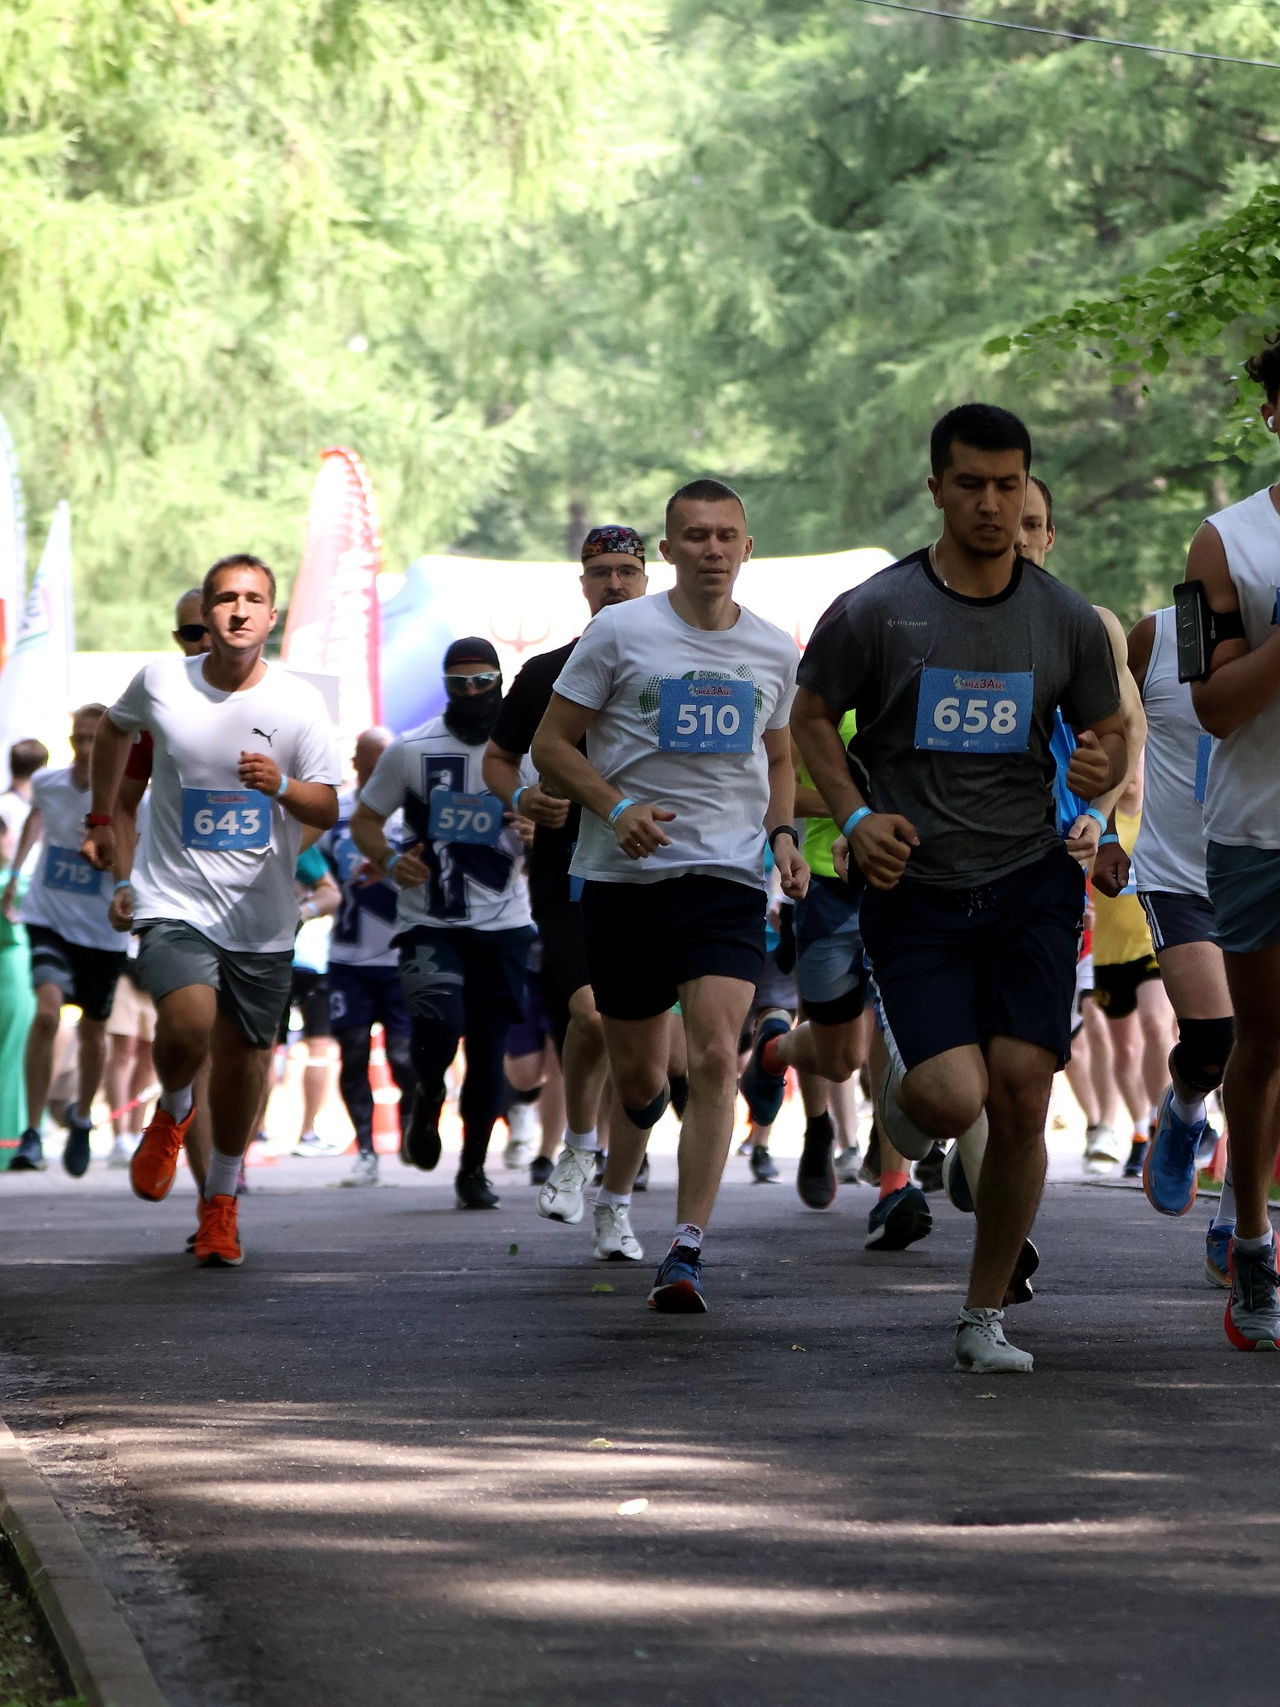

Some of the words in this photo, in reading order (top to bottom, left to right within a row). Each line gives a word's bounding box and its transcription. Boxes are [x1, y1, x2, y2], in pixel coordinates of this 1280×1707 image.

[677, 704, 740, 736] 510
[933, 697, 1017, 735] 658
[194, 809, 261, 836] 643
[438, 808, 492, 833] 570
